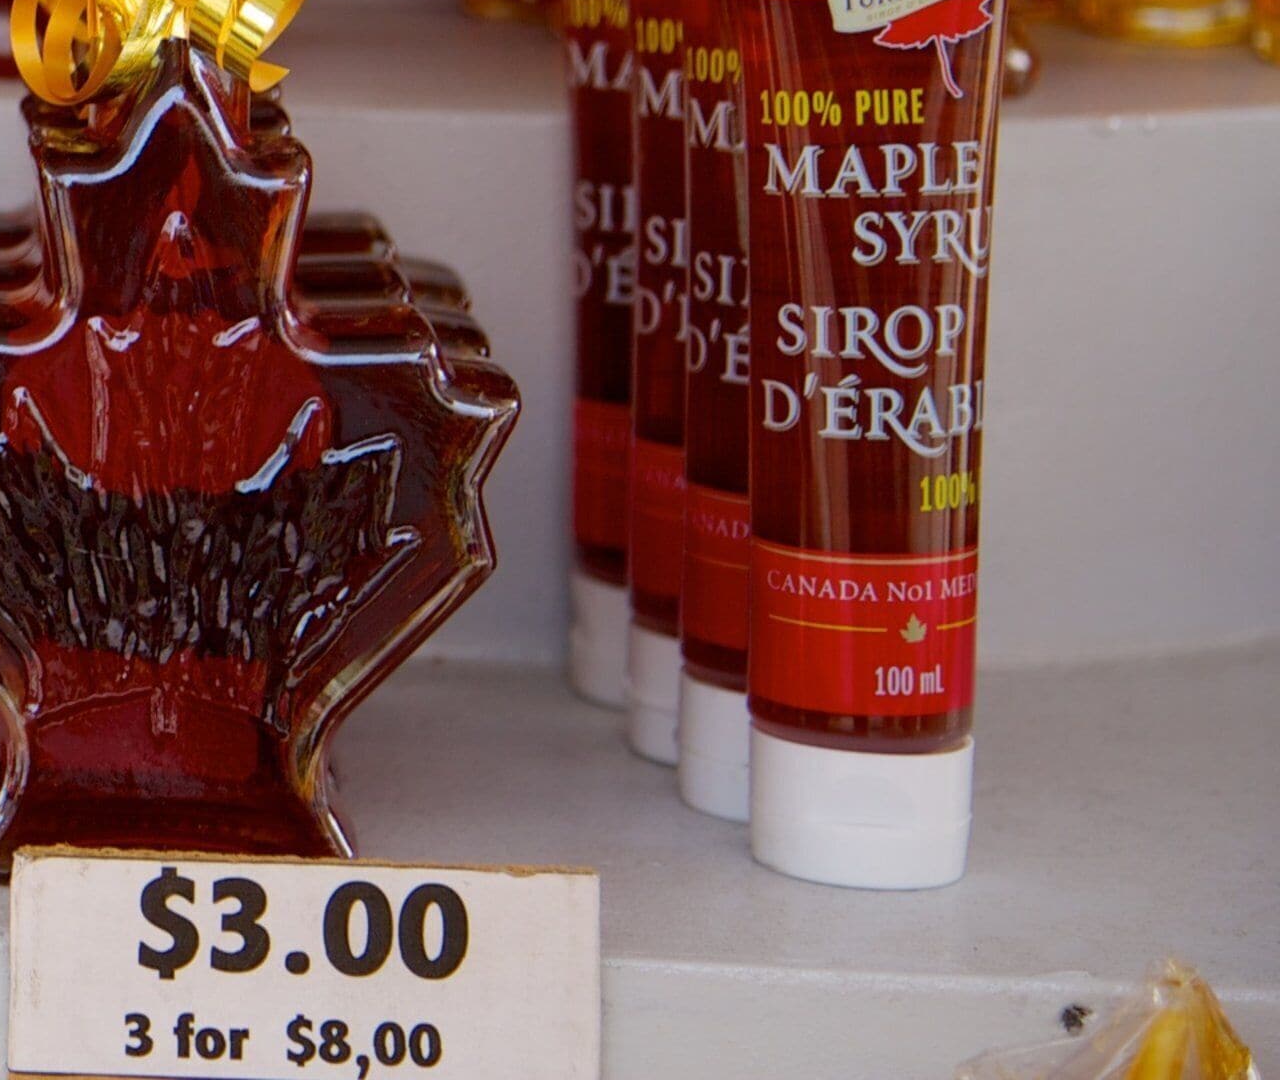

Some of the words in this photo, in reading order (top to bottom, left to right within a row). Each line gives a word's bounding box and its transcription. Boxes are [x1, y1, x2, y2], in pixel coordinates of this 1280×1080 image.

[760, 89, 842, 127] 100%
[855, 88, 925, 126] PURE
[763, 140, 981, 198] MAPLE
[851, 206, 993, 277] SYRU
[776, 302, 965, 378] SIROP
[761, 373, 985, 459] D'ÉRABL
[919, 470, 976, 513] 100%
[767, 570, 879, 602] CANADA
[939, 579, 978, 602] MED
[874, 666, 914, 697] 100
[920, 663, 944, 695] mL
[138, 867, 470, 980] $3.00
[123, 1012, 153, 1058] 3
[174, 1011, 249, 1060] for
[286, 1014, 442, 1080] $8,00
